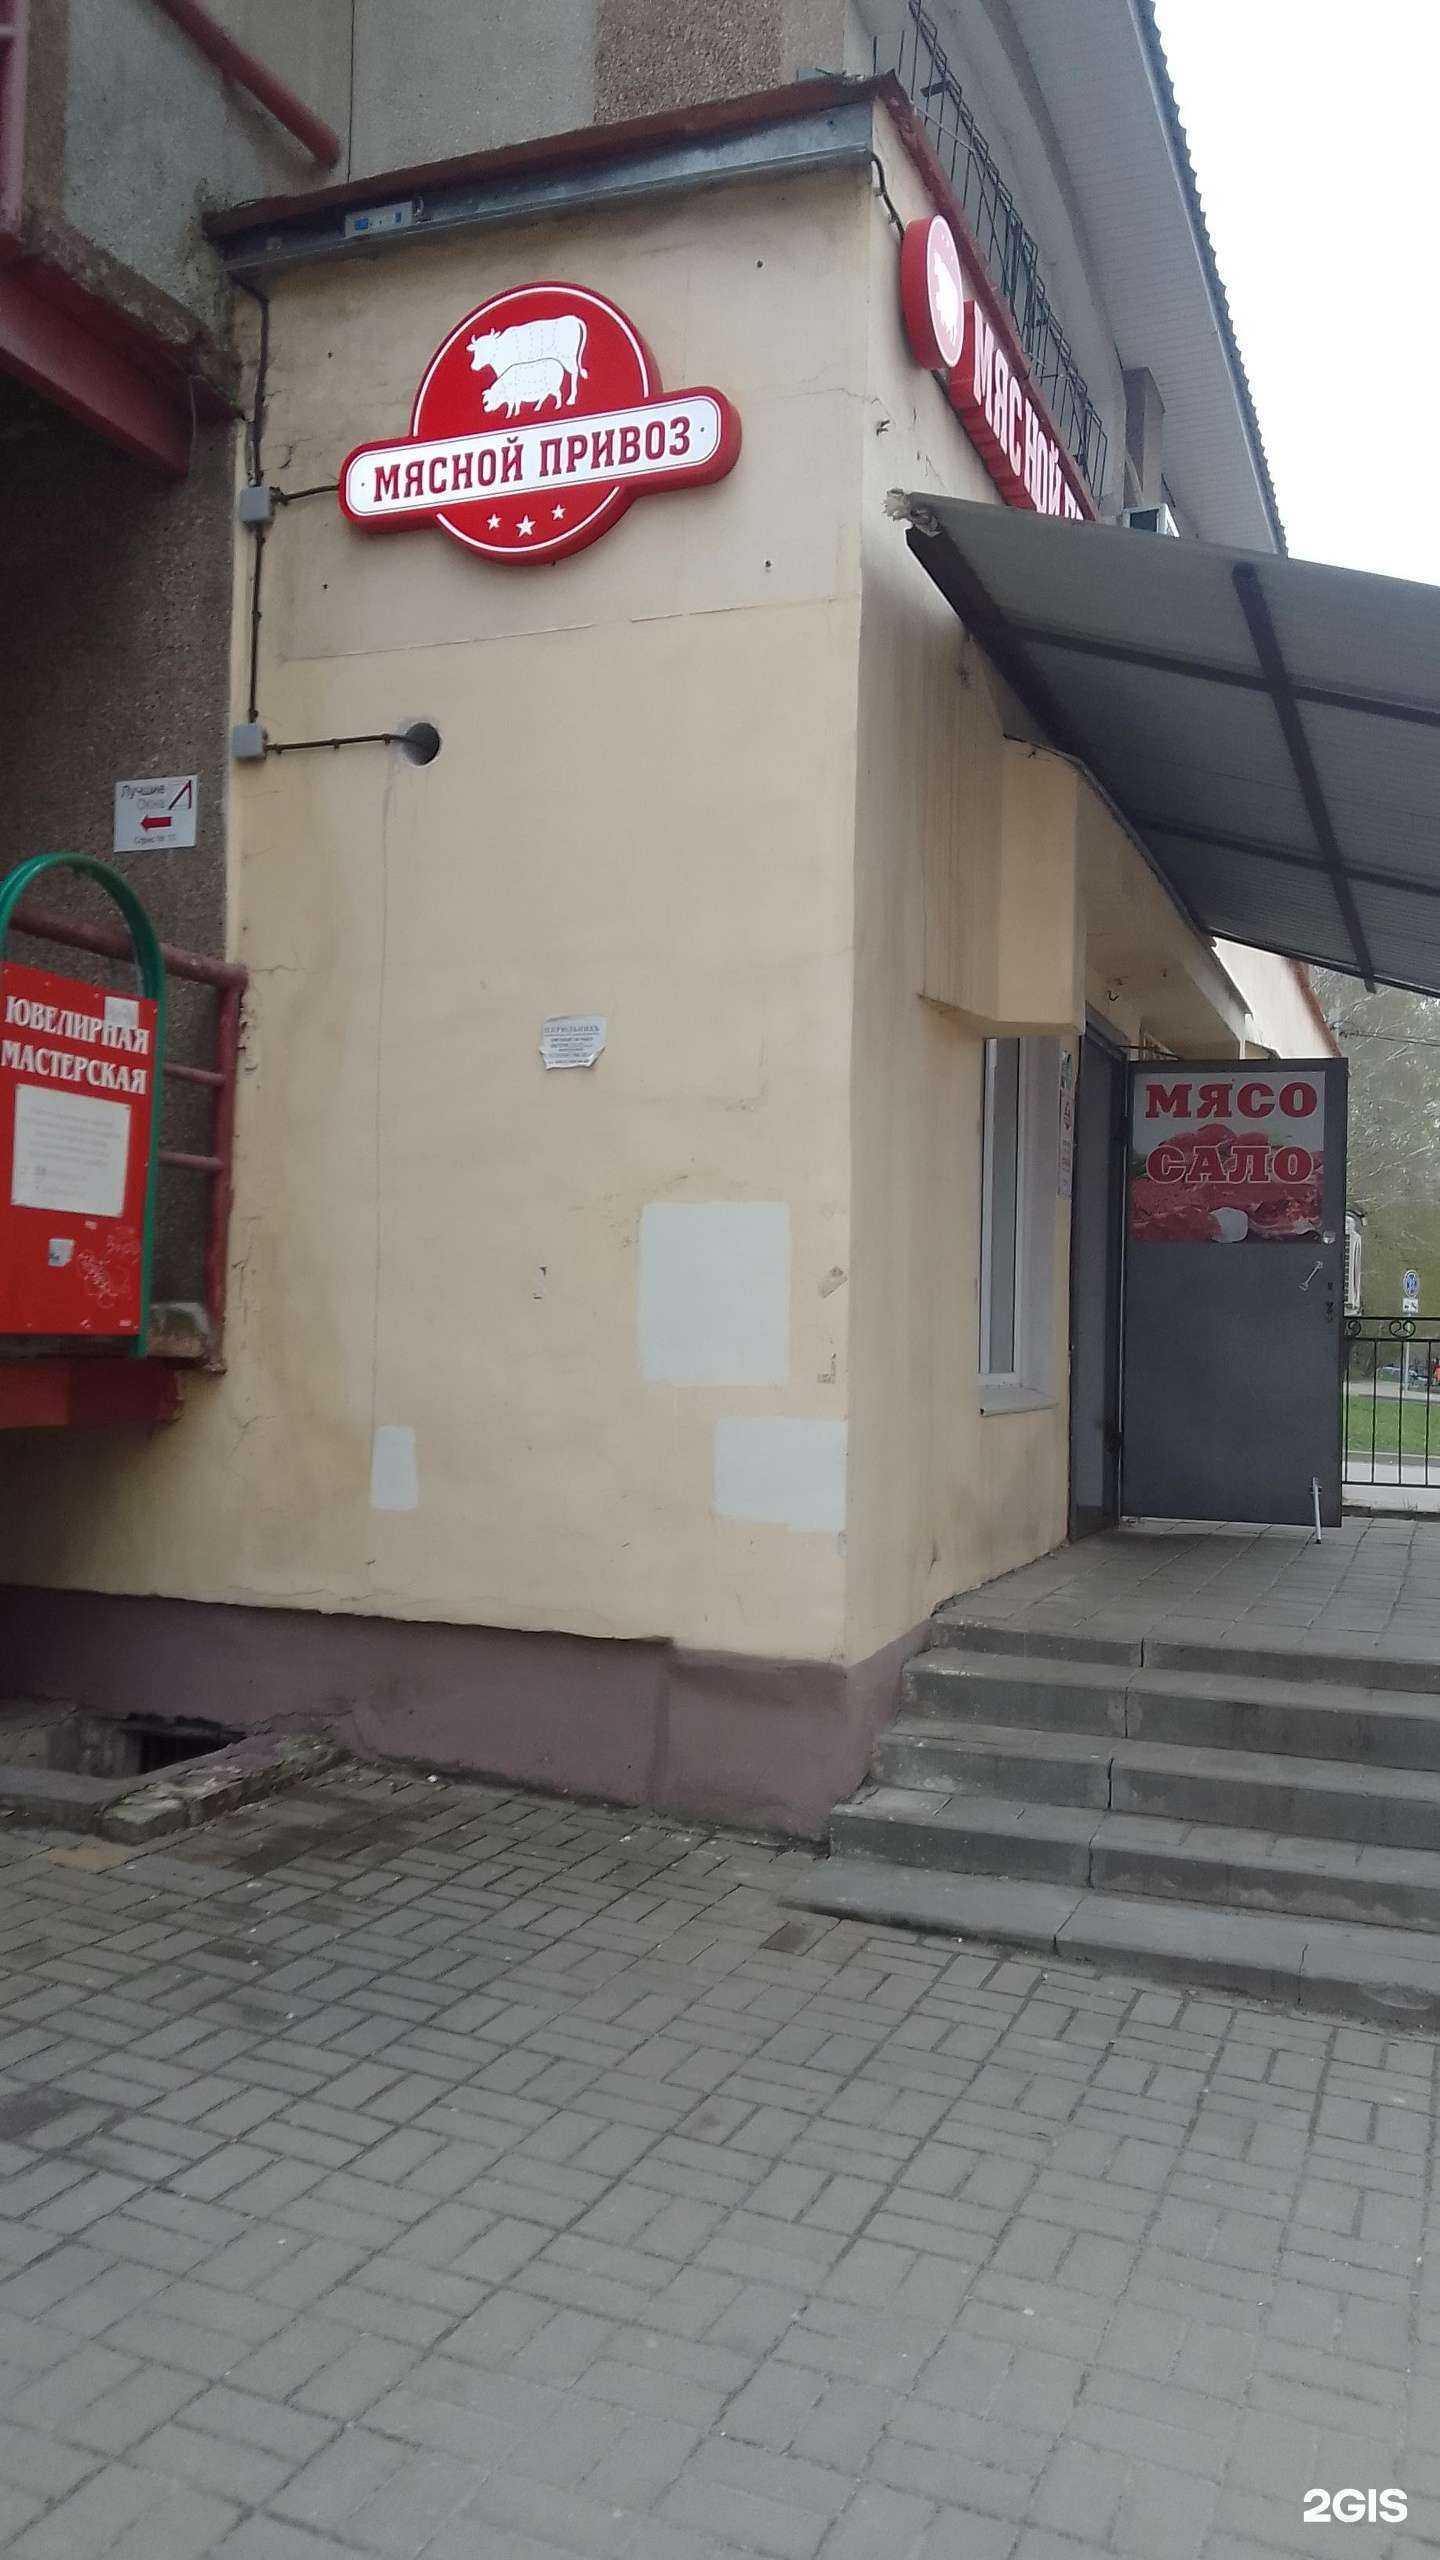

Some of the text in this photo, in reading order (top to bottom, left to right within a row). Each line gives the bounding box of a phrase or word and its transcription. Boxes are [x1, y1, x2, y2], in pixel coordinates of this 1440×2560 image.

[973, 301, 1062, 516] МЯСНОЙ
[374, 416, 691, 502] МЯСНОЙ ПРИВОЗ
[5, 995, 150, 1055] ЮВЕЛИРНАЯ
[0, 1040, 147, 1095] МАСТЕРСКАЯ
[1145, 1081, 1318, 1119] МЯСО
[1145, 1145, 1314, 1184] САЛО
